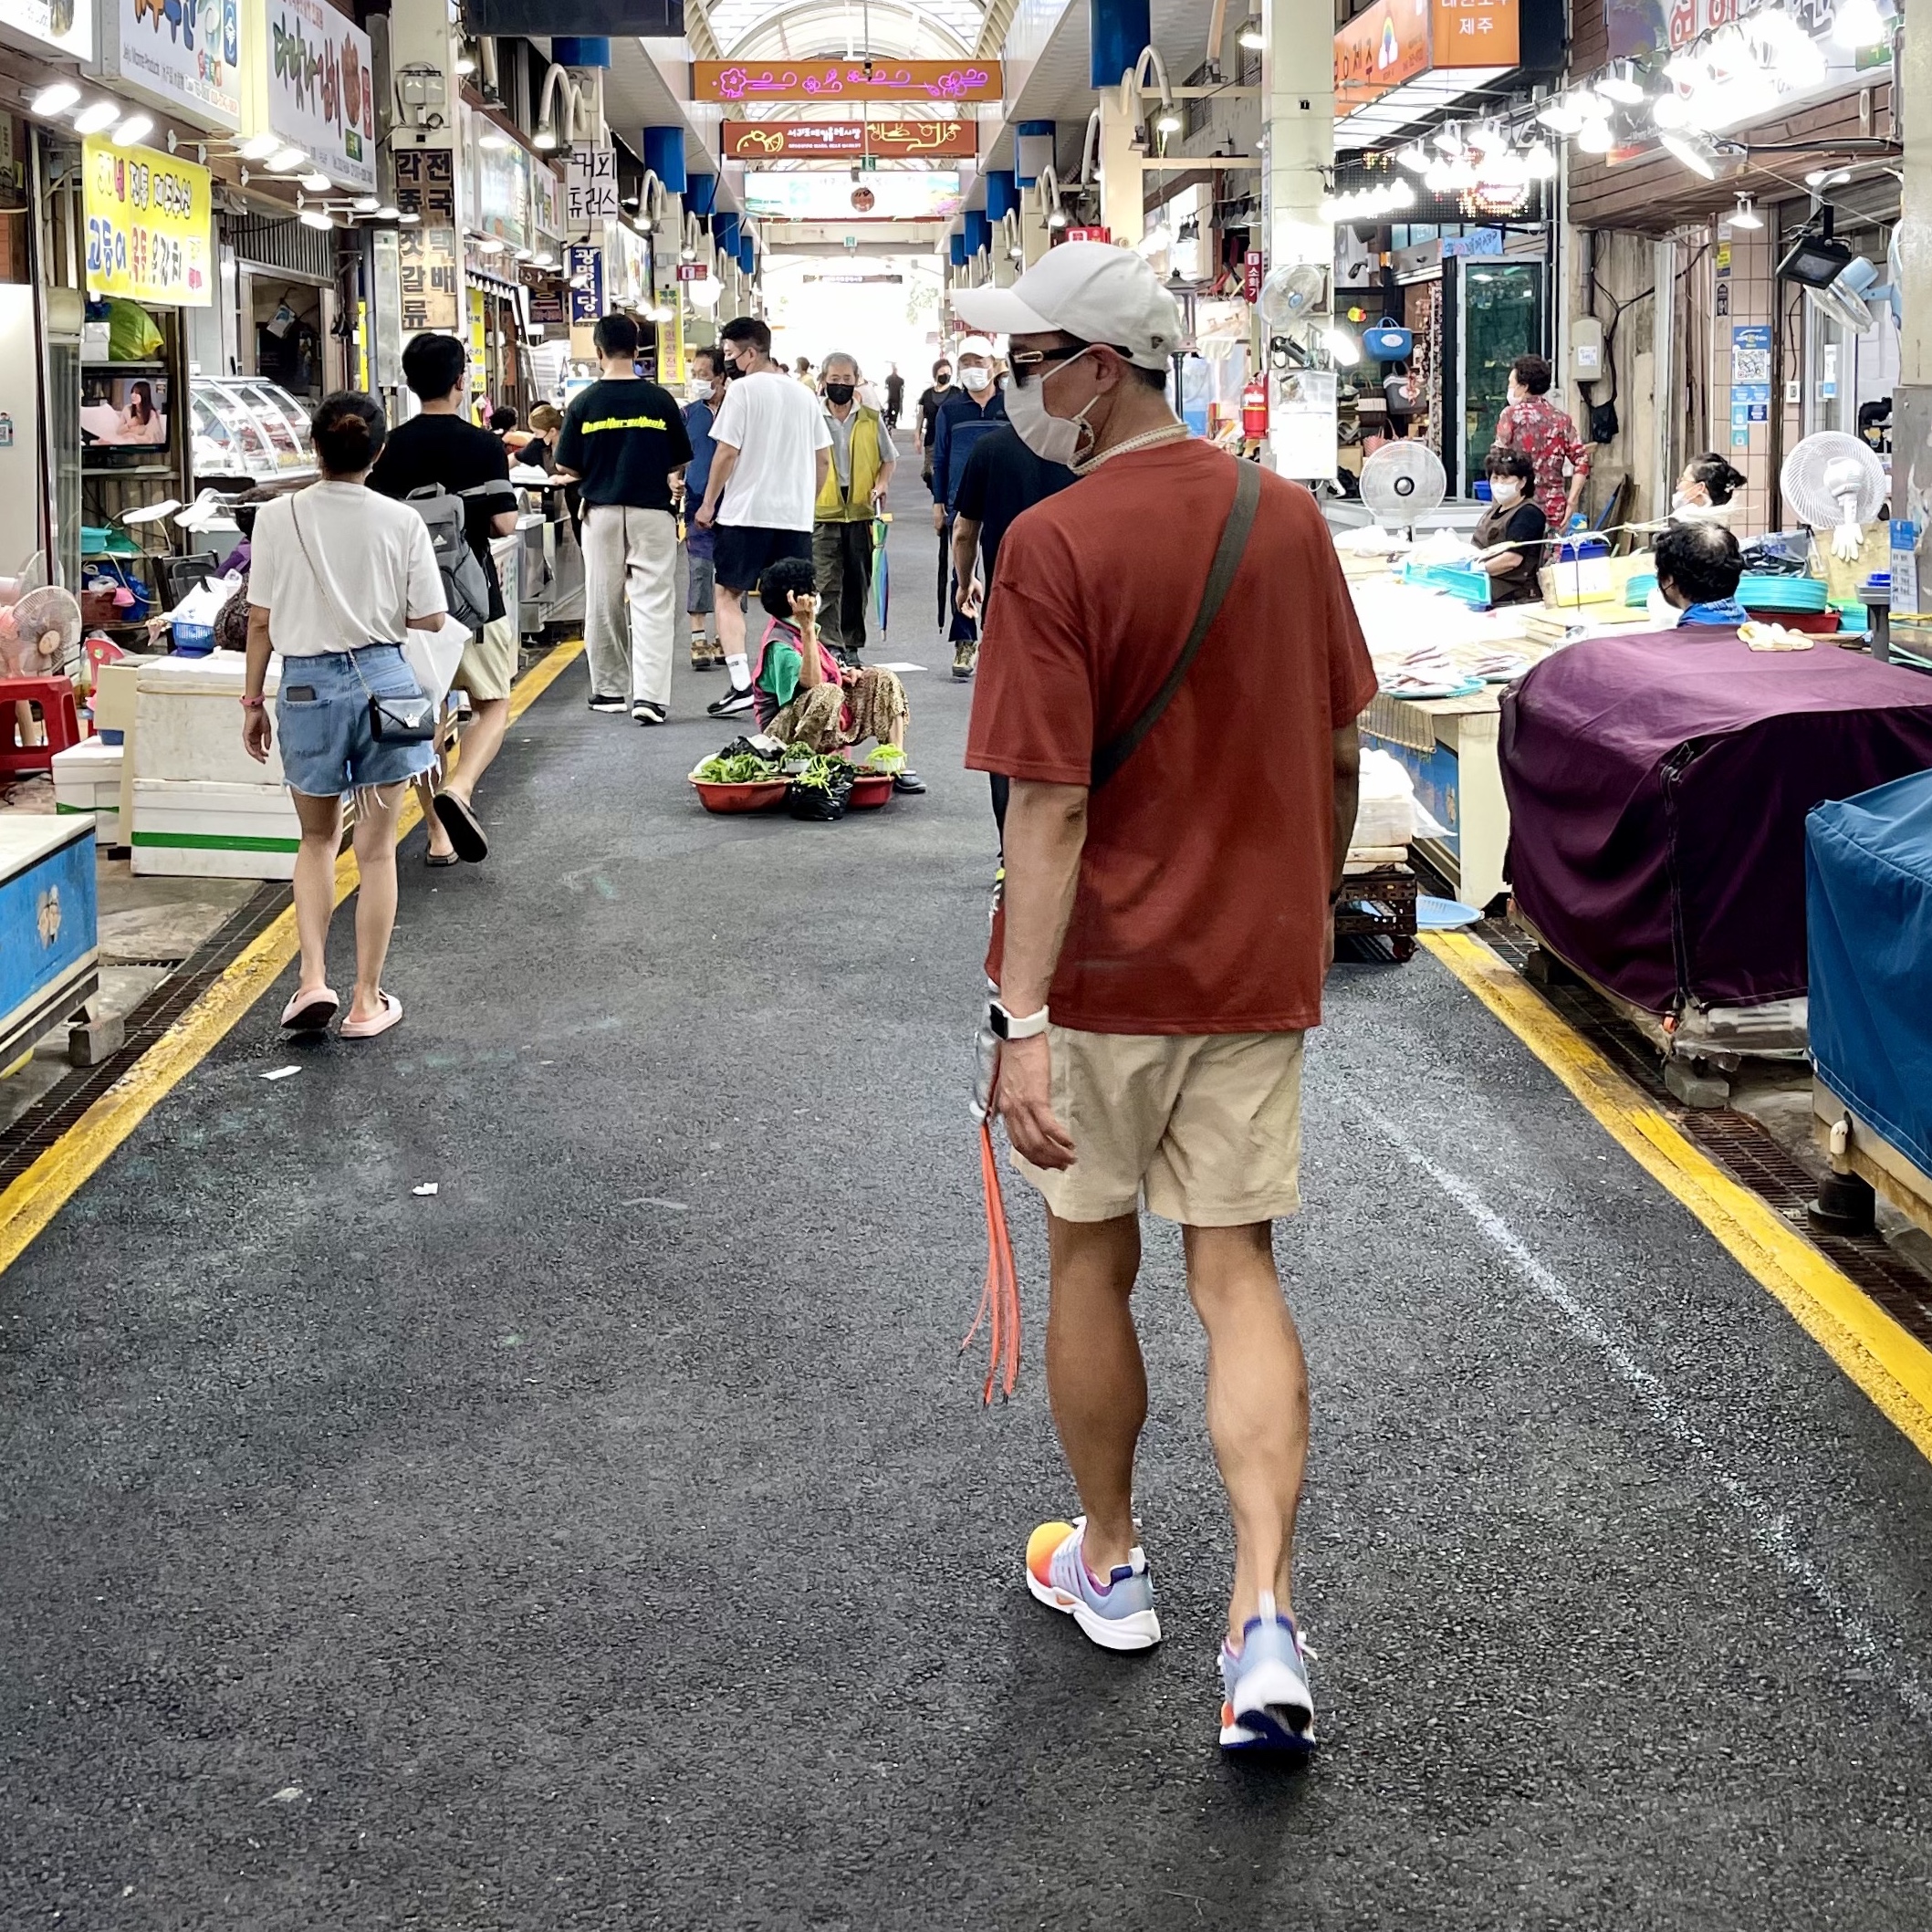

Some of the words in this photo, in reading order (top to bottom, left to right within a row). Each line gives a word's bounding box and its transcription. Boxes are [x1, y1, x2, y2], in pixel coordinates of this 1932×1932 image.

[1459, 17, 1493, 35] 제주
[397, 151, 423, 215] 각종
[426, 151, 453, 218] 전국
[572, 151, 616, 180] 커피
[568, 186, 617, 219] 츄러스
[399, 230, 428, 328] 젓갈류
[429, 230, 457, 295] 택배
[1248, 266, 1260, 298] 소화기
